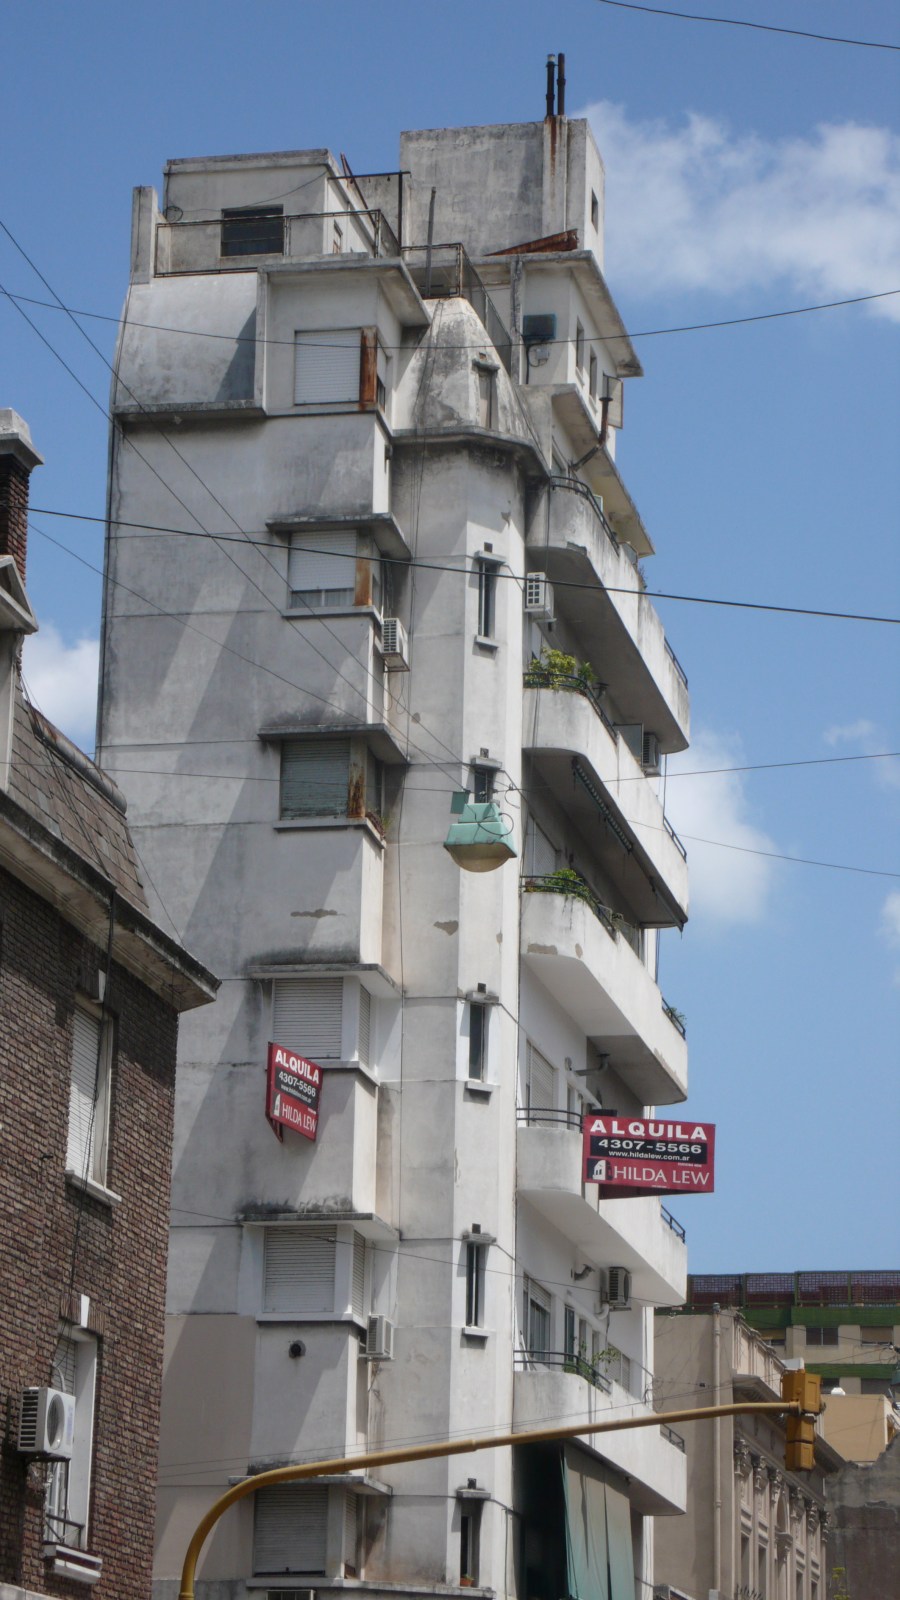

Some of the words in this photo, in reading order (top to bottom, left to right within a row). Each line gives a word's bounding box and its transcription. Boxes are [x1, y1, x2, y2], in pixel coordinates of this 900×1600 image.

[275, 1049, 320, 1085] ALQUILA
[278, 1071, 316, 1097] 4307-5566
[281, 1102, 302, 1126] HILDA
[303, 1113, 316, 1133] LEW
[590, 1119, 707, 1140] ALQUILA
[598, 1139, 702, 1154] 4307-5566
[608, 1150, 690, 1161] www.hildalew.com.ar
[613, 1166, 667, 1182] HILDA
[672, 1170, 710, 1185] LEW
